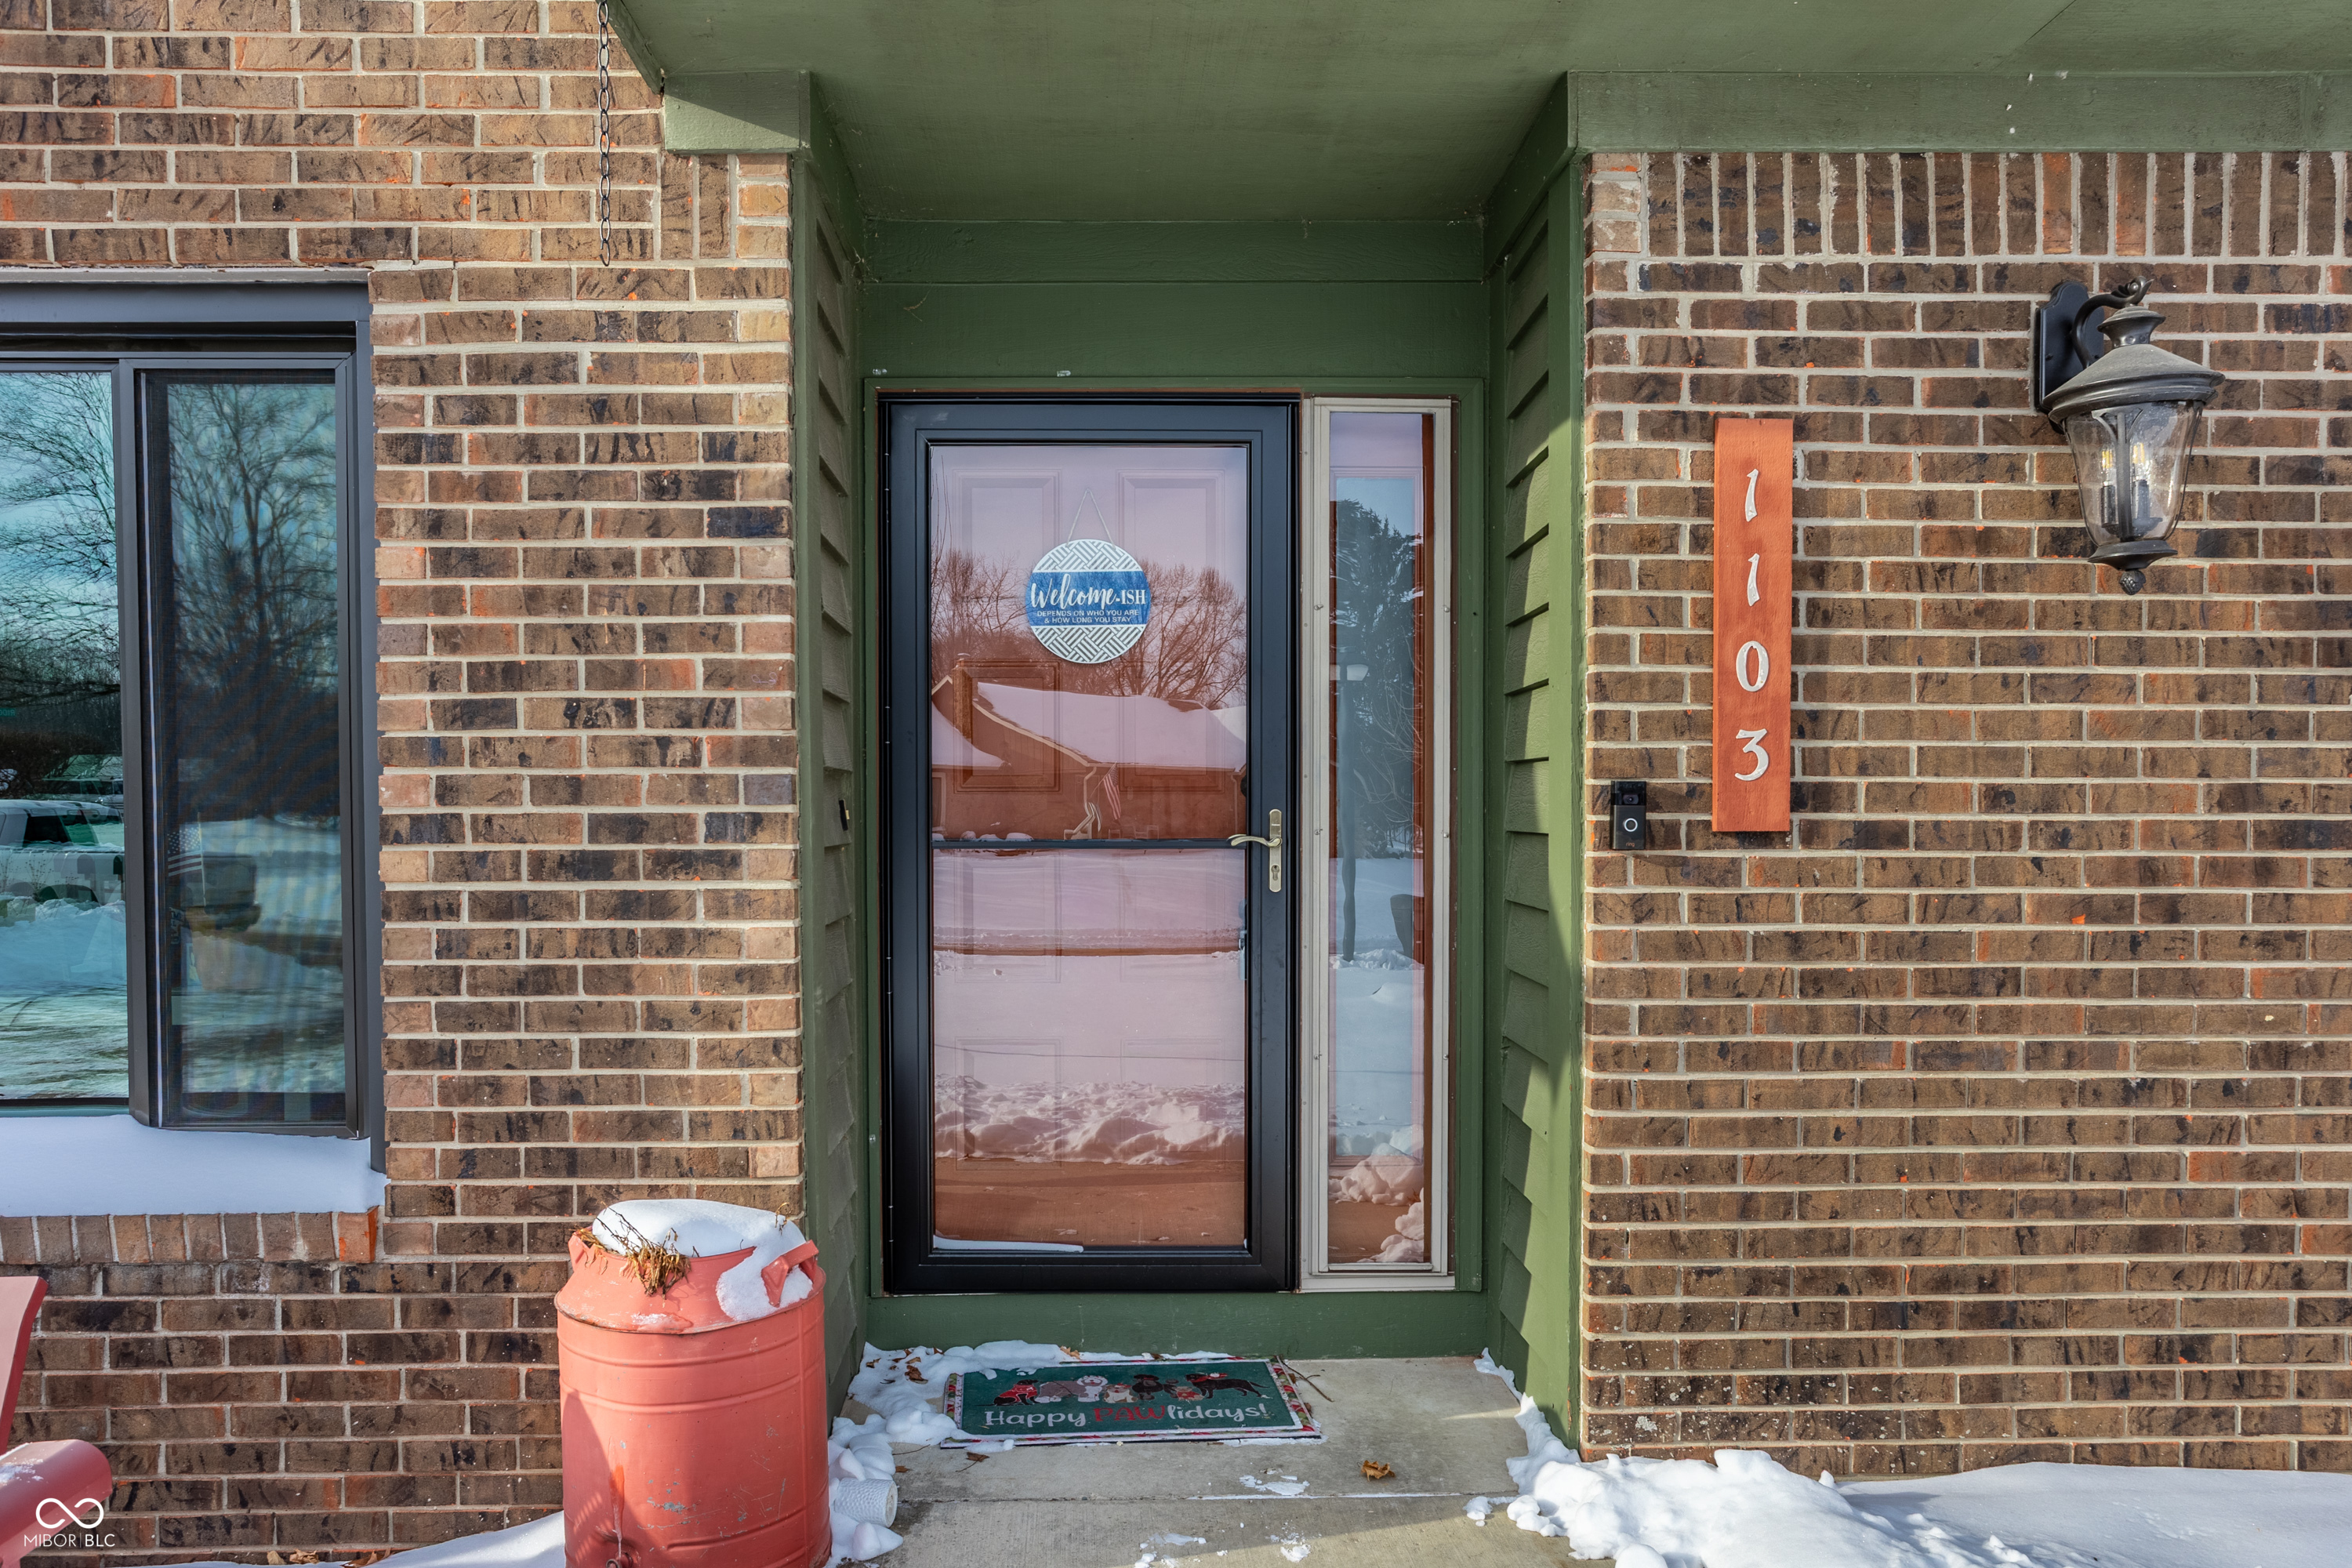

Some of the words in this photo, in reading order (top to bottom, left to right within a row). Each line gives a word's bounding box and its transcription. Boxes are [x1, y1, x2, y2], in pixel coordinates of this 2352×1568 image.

[1031, 573, 1146, 610] Welcome-ISH
[1734, 468, 1769, 782] 1103
[985, 1410, 1087, 1428] Happy
[1094, 1403, 1267, 1422] PAWlidays!
